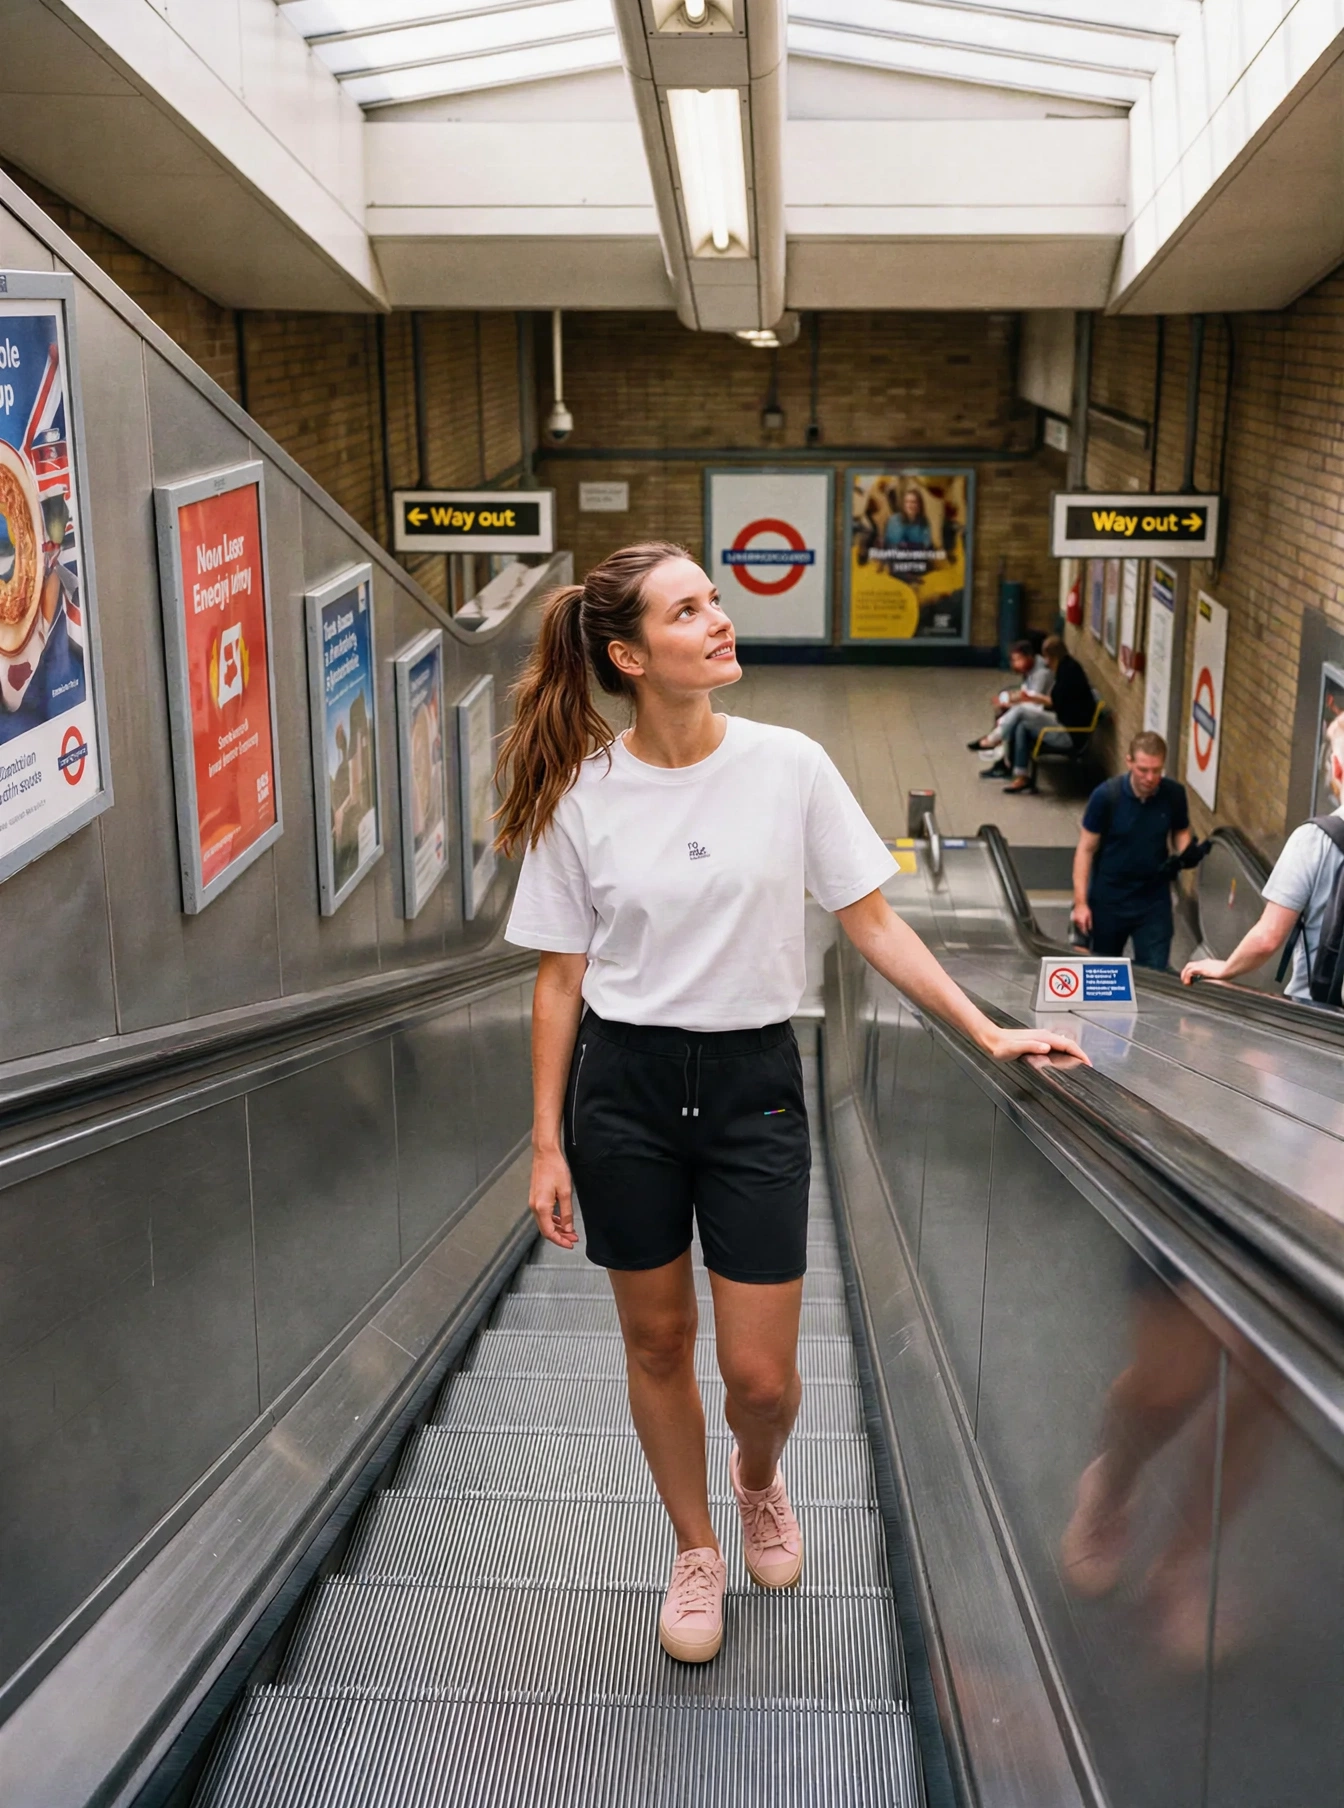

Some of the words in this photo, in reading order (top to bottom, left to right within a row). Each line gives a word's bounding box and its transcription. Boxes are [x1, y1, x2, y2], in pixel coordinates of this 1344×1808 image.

[430, 507, 475, 531] Way
[478, 509, 516, 527] out
[1092, 511, 1138, 537] Way
[1141, 513, 1179, 532] out
